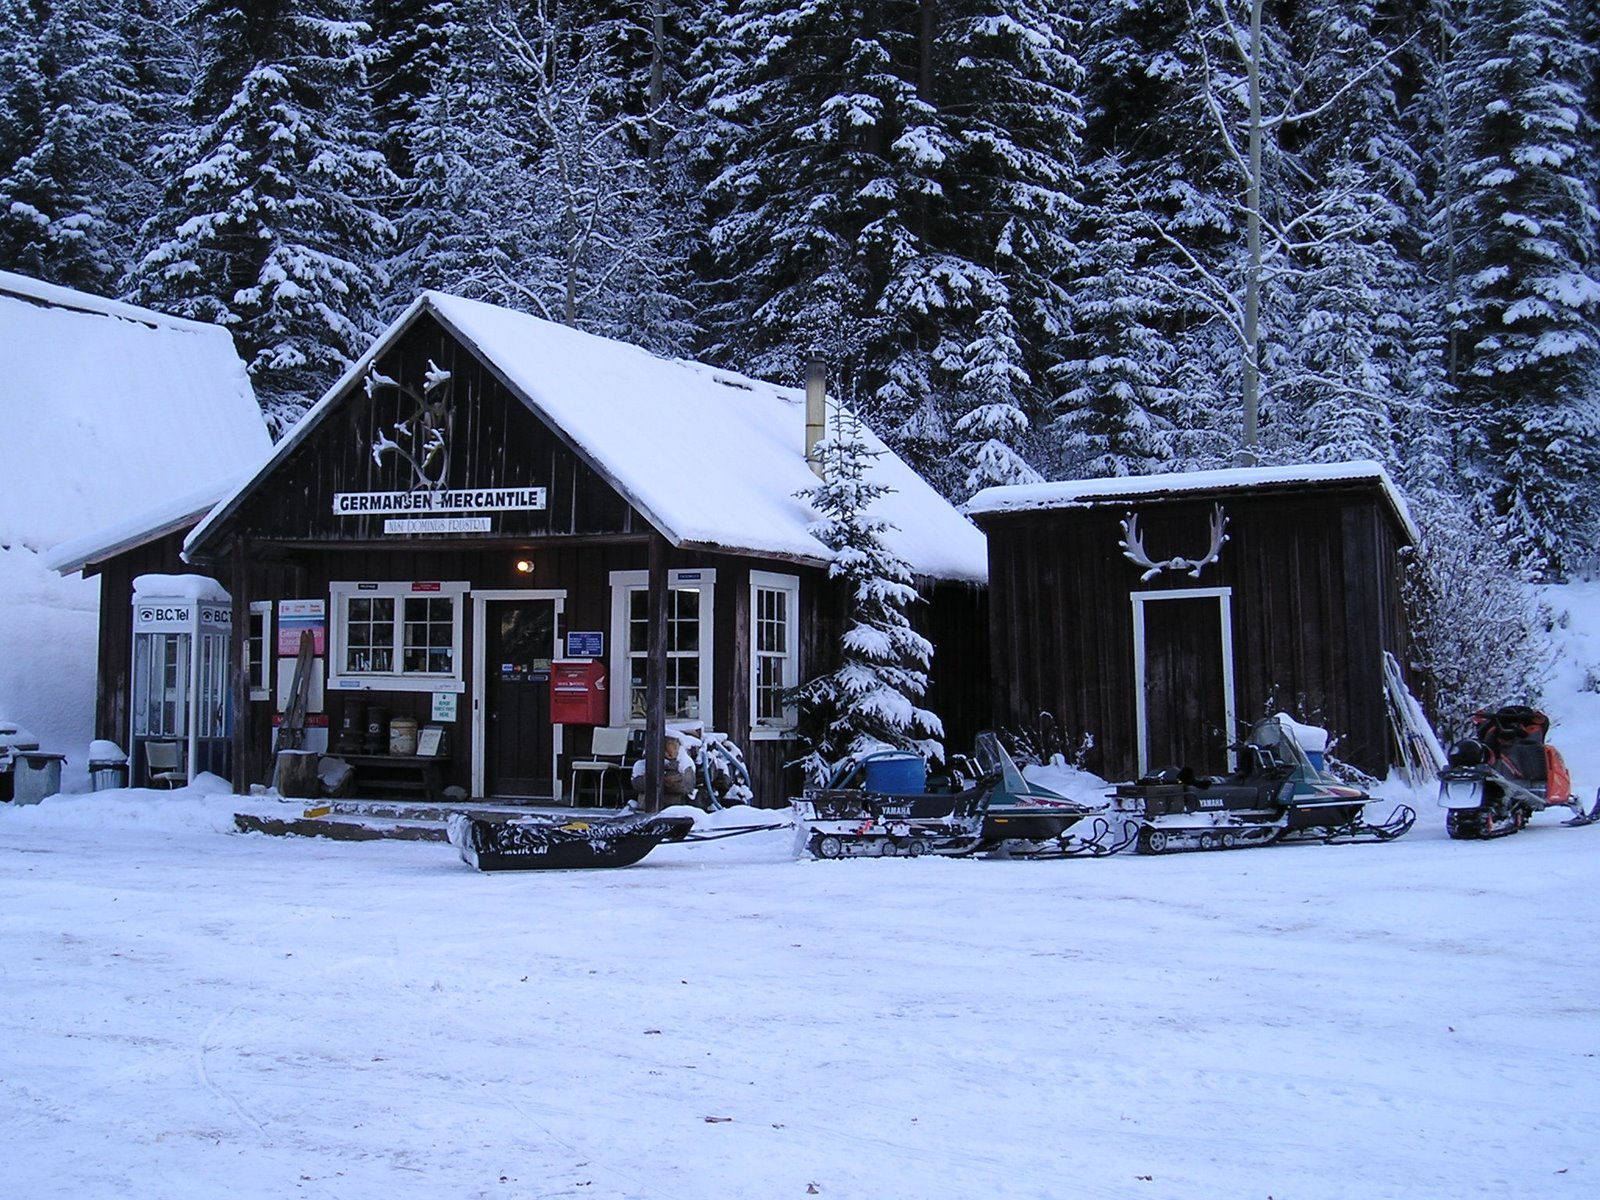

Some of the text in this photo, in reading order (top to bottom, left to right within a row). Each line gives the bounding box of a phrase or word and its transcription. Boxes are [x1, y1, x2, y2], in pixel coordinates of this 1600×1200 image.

[340, 491, 538, 511] GERMANSEN MERCANTILE
[1199, 799, 1224, 807] YAMAHA
[881, 806, 911, 815] YAMAHA
